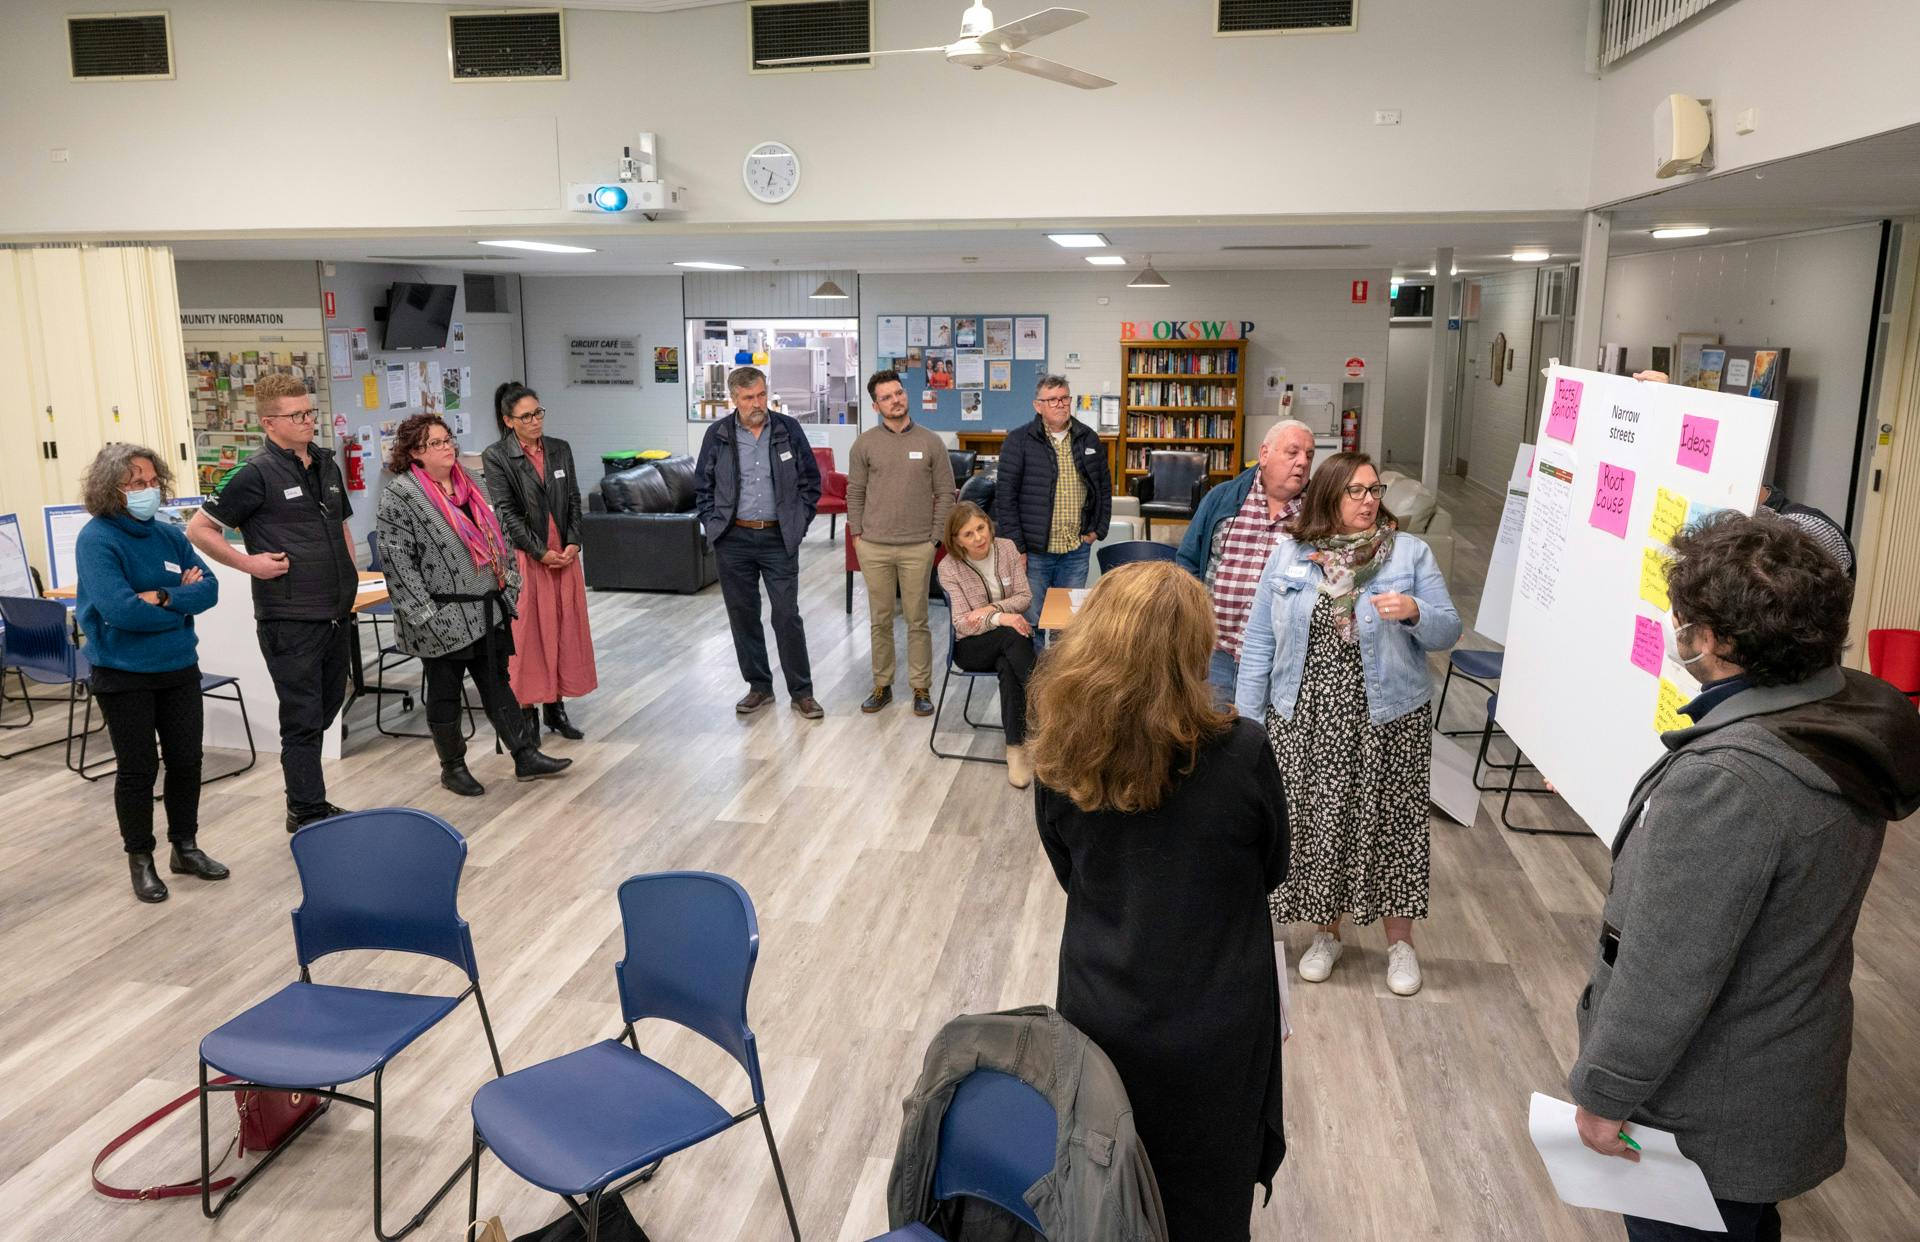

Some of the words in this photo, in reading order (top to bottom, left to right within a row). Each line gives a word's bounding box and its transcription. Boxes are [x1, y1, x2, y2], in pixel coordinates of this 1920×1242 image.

[218, 314, 284, 325] INFORMATION
[571, 340, 599, 349] CIRCUIT
[1611, 404, 1641, 423] Narrow
[1609, 426, 1635, 444] streets
[1680, 424, 1712, 457] Ideas
[1603, 464, 1625, 491] Root
[1597, 489, 1625, 514] Cause
